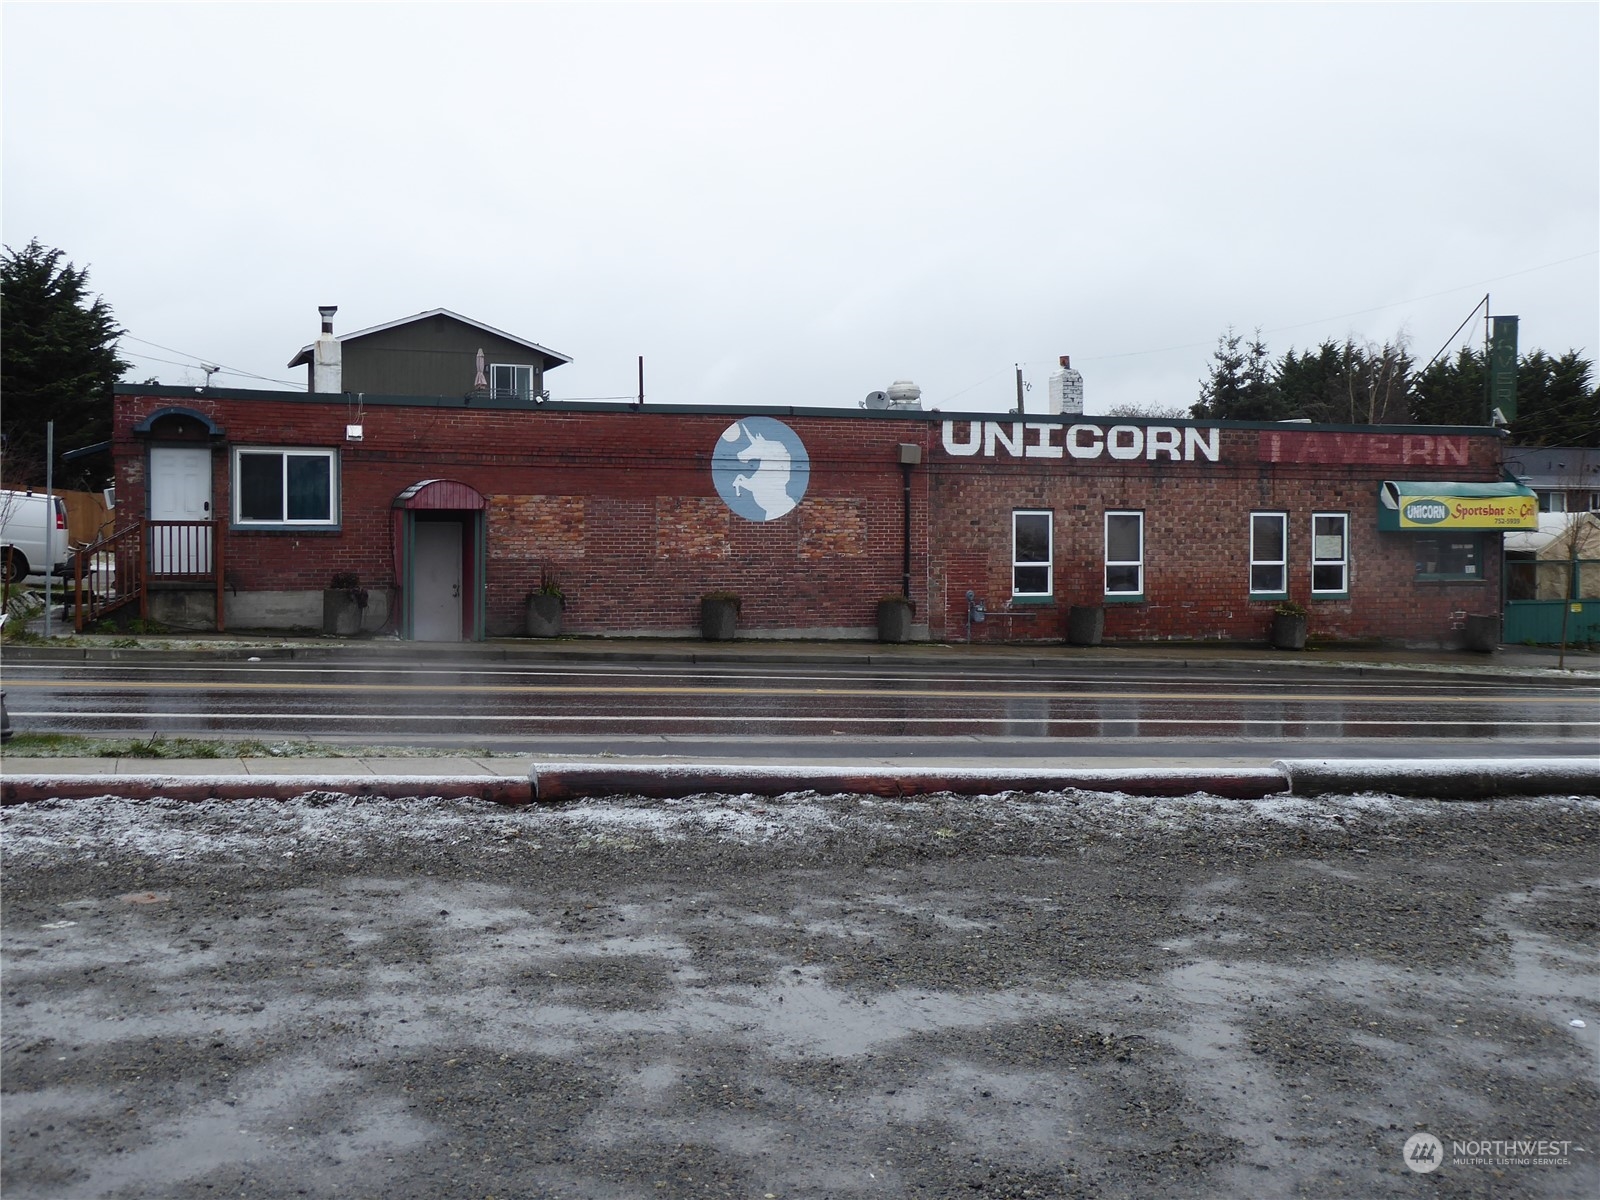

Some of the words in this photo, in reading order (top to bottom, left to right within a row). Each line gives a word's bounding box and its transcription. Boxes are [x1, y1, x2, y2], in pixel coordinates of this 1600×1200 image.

[942, 420, 1220, 462] UNICORN
[1407, 505, 1446, 519] UNICORN
[1451, 504, 1506, 520] Sportsbar
[1508, 506, 1518, 516] &
